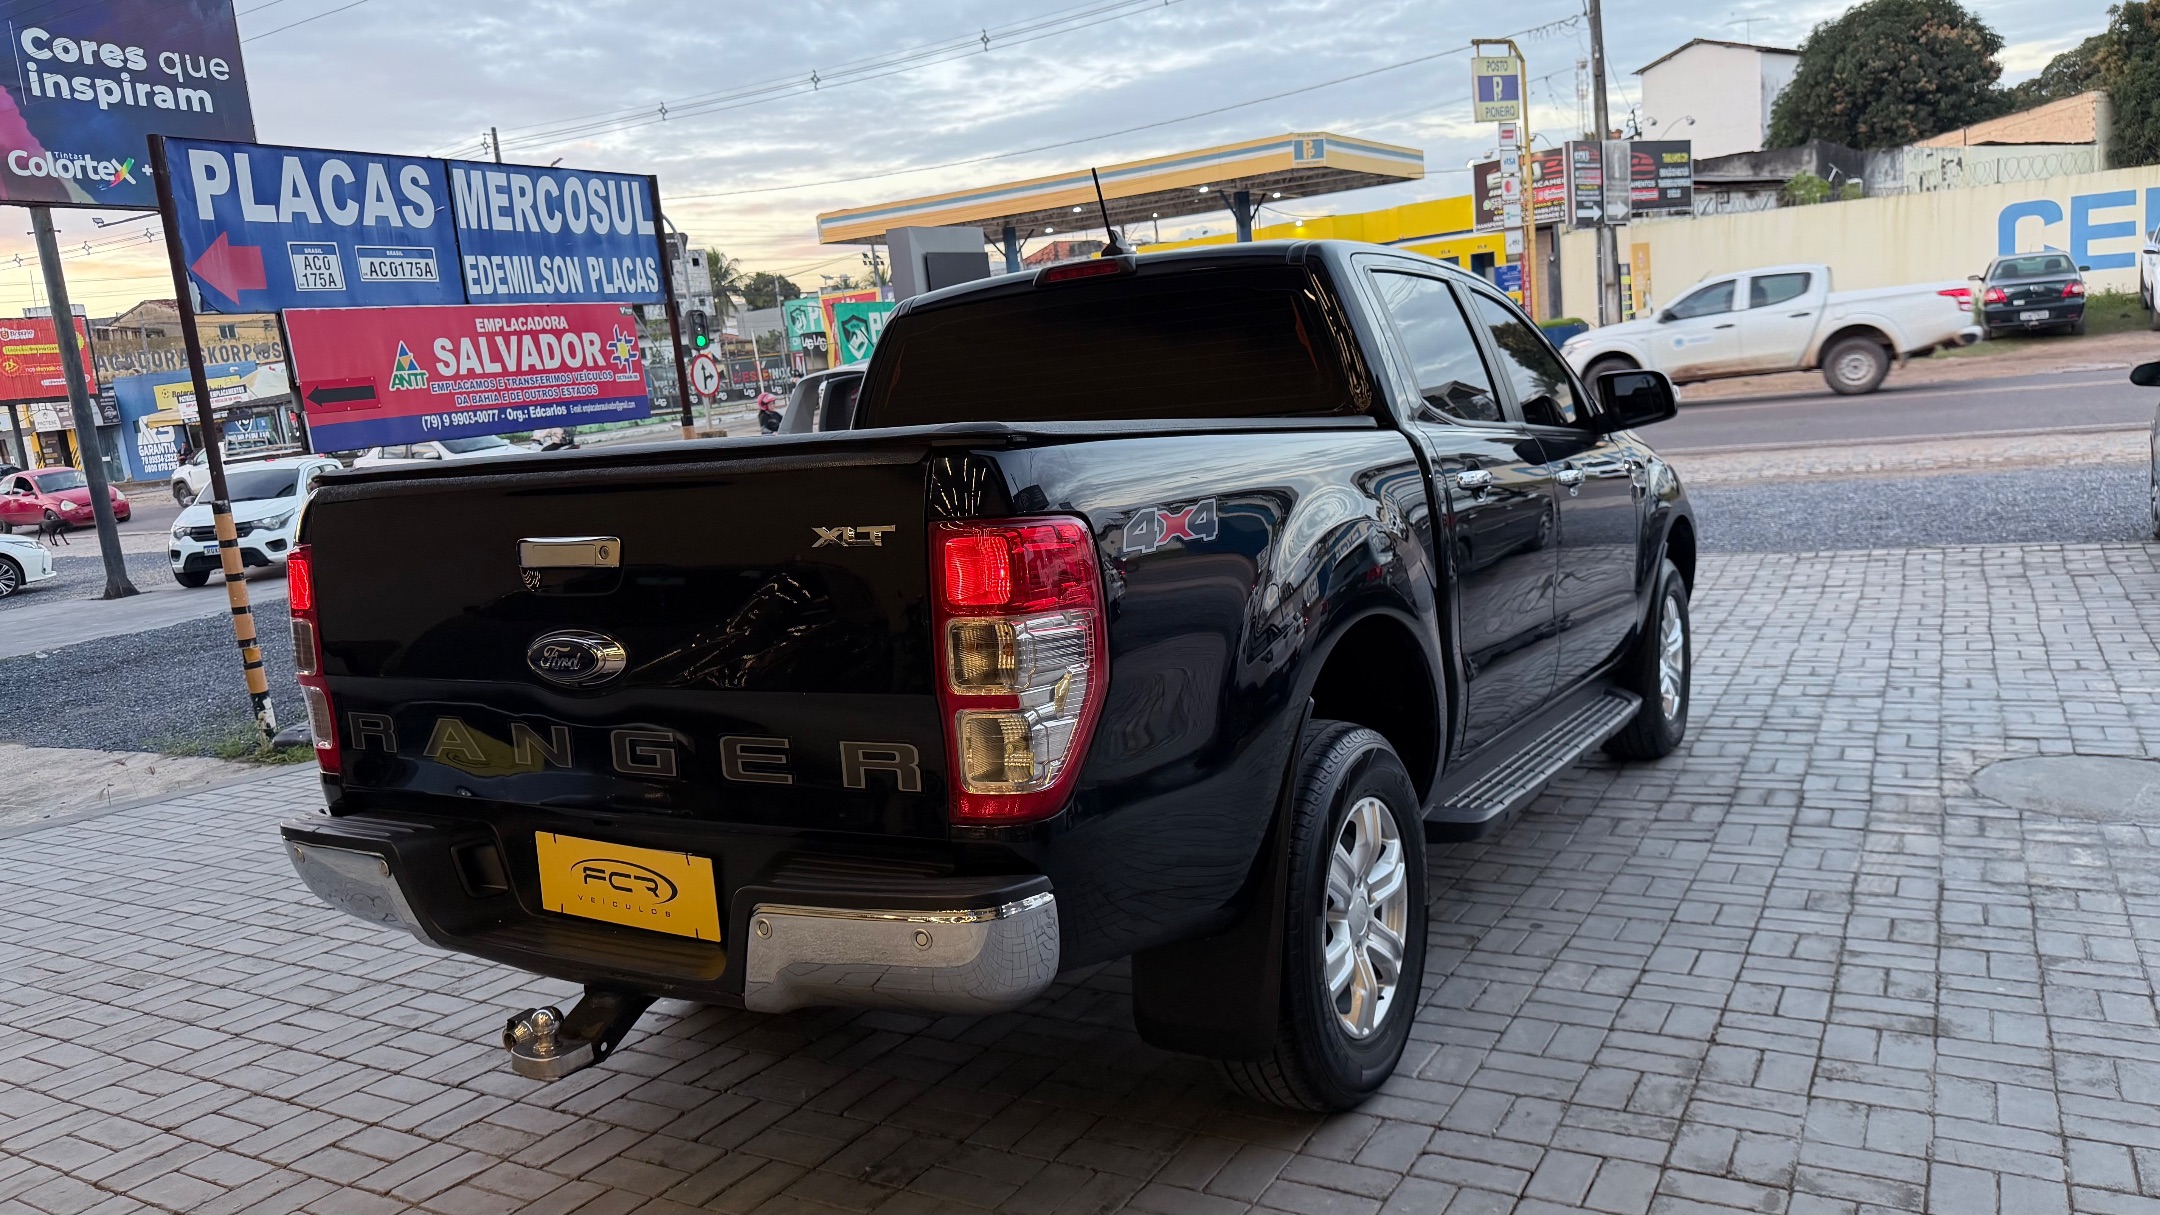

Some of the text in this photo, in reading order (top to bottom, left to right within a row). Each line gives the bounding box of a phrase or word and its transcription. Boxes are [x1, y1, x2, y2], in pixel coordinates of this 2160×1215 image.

[21, 27, 230, 83] Cores que
[1486, 60, 1508, 72] POSTO
[27, 62, 214, 113] inspiram
[1485, 105, 1515, 118] PIONEIRO
[54, 151, 83, 160] Tintas
[188, 149, 435, 229] PLACAS
[452, 168, 656, 235] MERCOSUL
[302, 273, 337, 288] 175A
[464, 255, 659, 295] EDEMILSON PLACAS
[475, 315, 569, 333] EMPLACADORA
[433, 331, 606, 376] SALVADOR
[390, 370, 428, 391] ANTT
[430, 369, 613, 394] EMPLACAMOS E TRANSFERIMOS VEÍCULOS
[456, 385, 598, 406] DA BAHIA E DE OUTROS ESTADOS
[422, 414, 441, 432] (79)
[443, 413, 450, 427] 9
[451, 409, 499, 426] 9903-0077
[529, 404, 567, 419] Edcarlos
[138, 442, 178, 457] GARANTIA
[810, 524, 896, 548] XLT
[540, 645, 580, 671] Ford
[346, 711, 924, 792] RANGER
[583, 866, 661, 898] FCR
